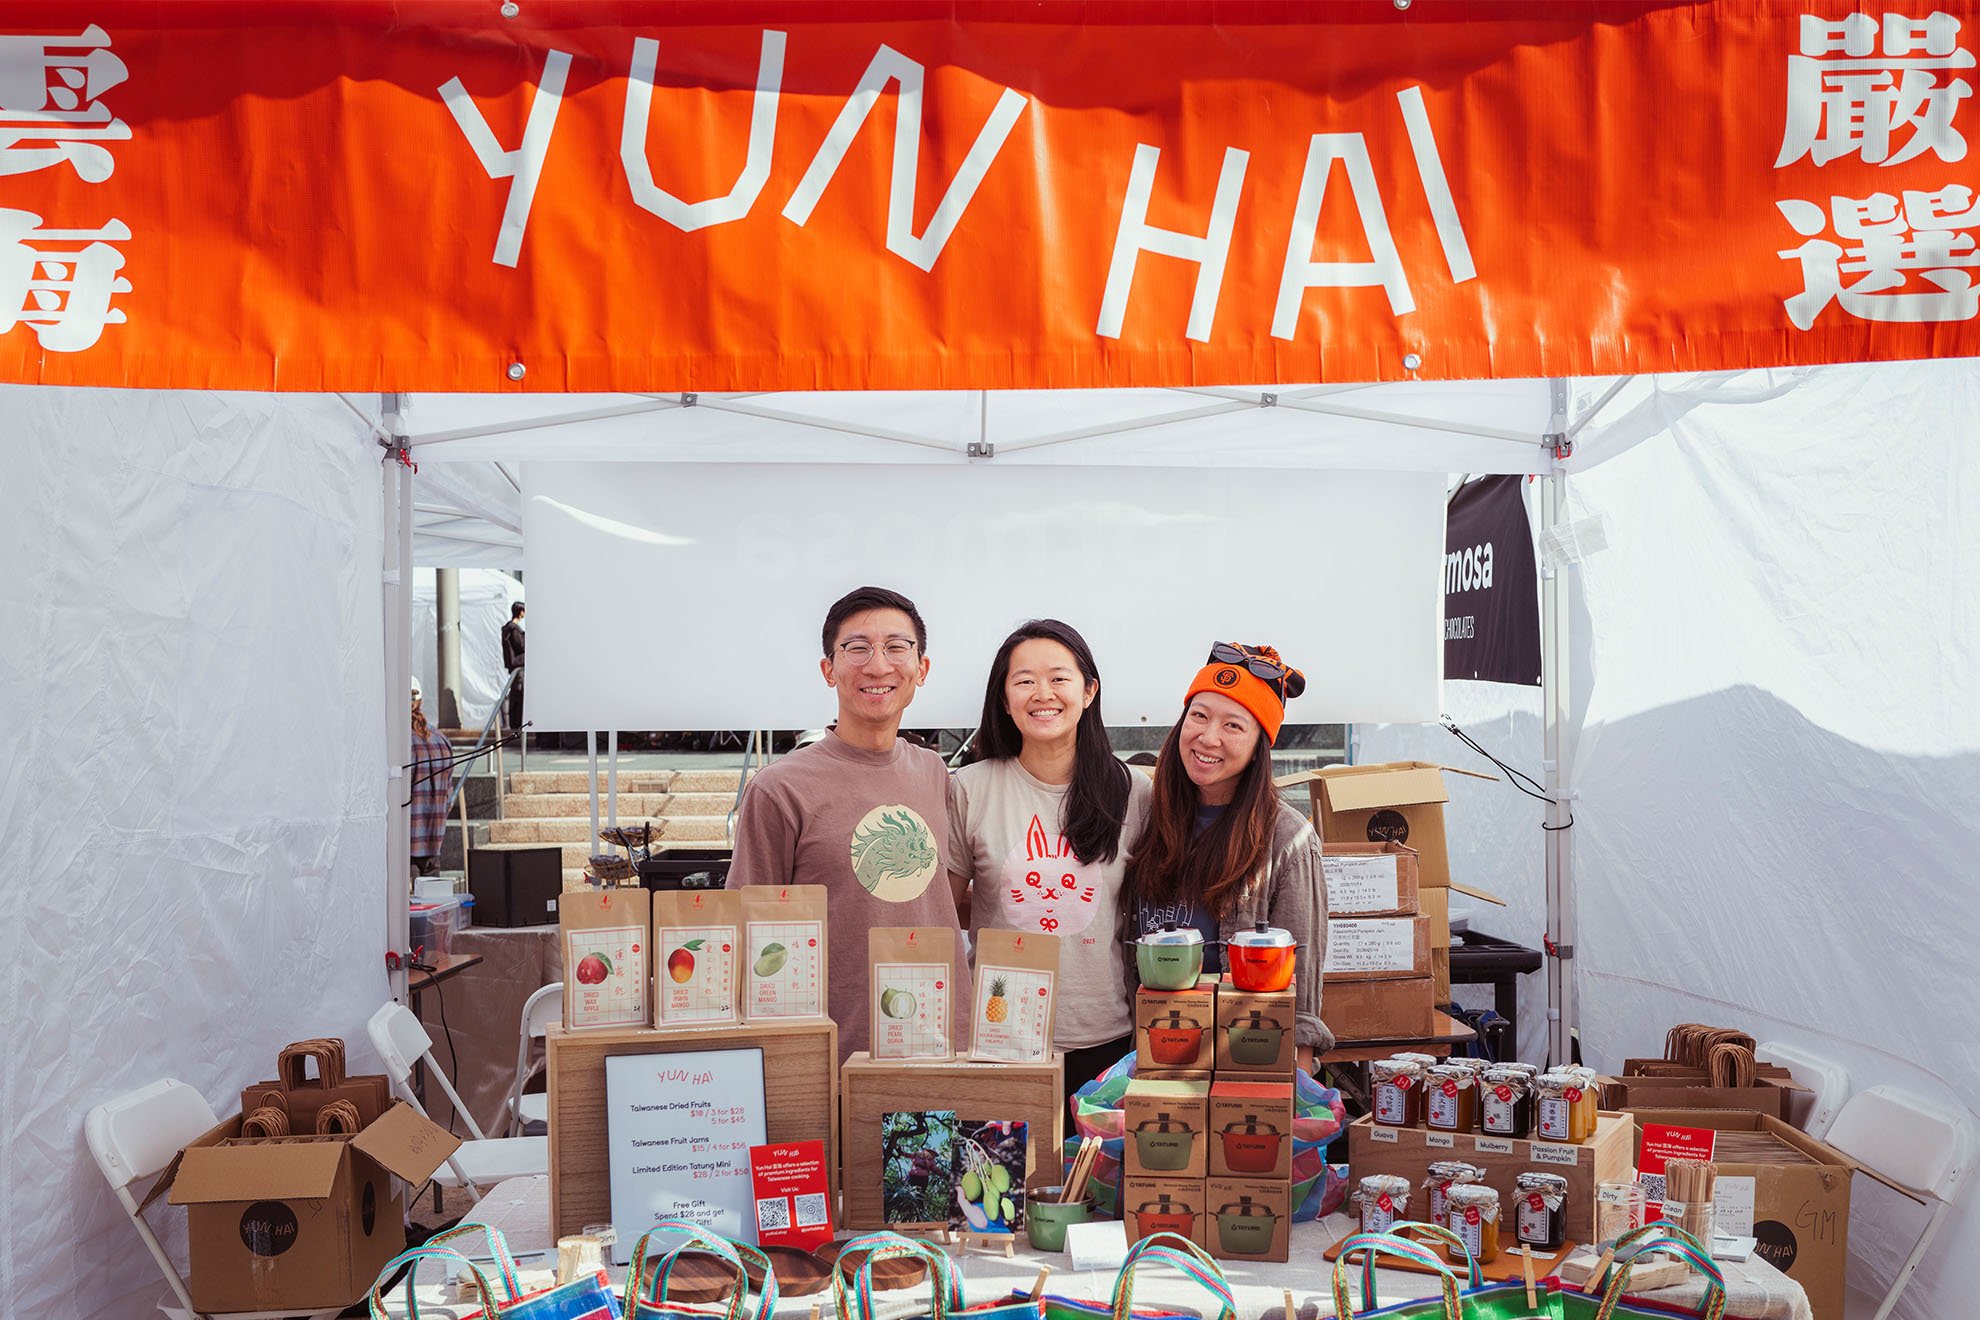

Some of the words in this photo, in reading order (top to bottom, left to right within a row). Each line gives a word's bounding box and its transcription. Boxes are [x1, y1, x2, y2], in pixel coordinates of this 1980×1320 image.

[1774, 11, 1980, 331] 嚴選
[437, 29, 1028, 272] YUN
[1096, 85, 1477, 343] HAI
[1392, 825, 1406, 836] HAI
[658, 1070, 689, 1083] YUN
[692, 1070, 714, 1086] HAI
[631, 1103, 668, 1112] Taiwanese
[669, 1102, 689, 1110] Dried
[691, 1100, 711, 1109] Fruits
[730, 1107, 745, 1116] $28
[731, 1116, 745, 1124] $45
[1374, 1131, 1394, 1140] Guava
[632, 1139, 668, 1148] Taiwanese
[689, 1136, 709, 1144] Jams
[1429, 1136, 1450, 1146] Mango
[692, 1144, 705, 1153] $15
[732, 1142, 746, 1150] $56
[1480, 1142, 1508, 1152] Mulberry
[1532, 1146, 1557, 1154] Passion
[1560, 1146, 1574, 1155] Fruit
[773, 1149, 788, 1158] YUN
[789, 1149, 800, 1157] HAI
[1542, 1154, 1572, 1163] Pumpkin
[632, 1165, 661, 1174] Limited
[662, 1164, 688, 1172] Edition
[690, 1162, 715, 1171] Tatung
[693, 1171, 708, 1180] $28
[1602, 1191, 1618, 1200] Dirty
[691, 1200, 705, 1208] Gift
[1664, 1204, 1682, 1214] Clean
[654, 1213, 678, 1221] Spend
[680, 1211, 695, 1219] $28
[713, 1209, 724, 1217] get
[242, 1220, 272, 1234] YUN
[275, 1222, 294, 1236] HAI
[696, 1219, 712, 1227] Gift!
[1773, 1244, 1794, 1258] HAI
